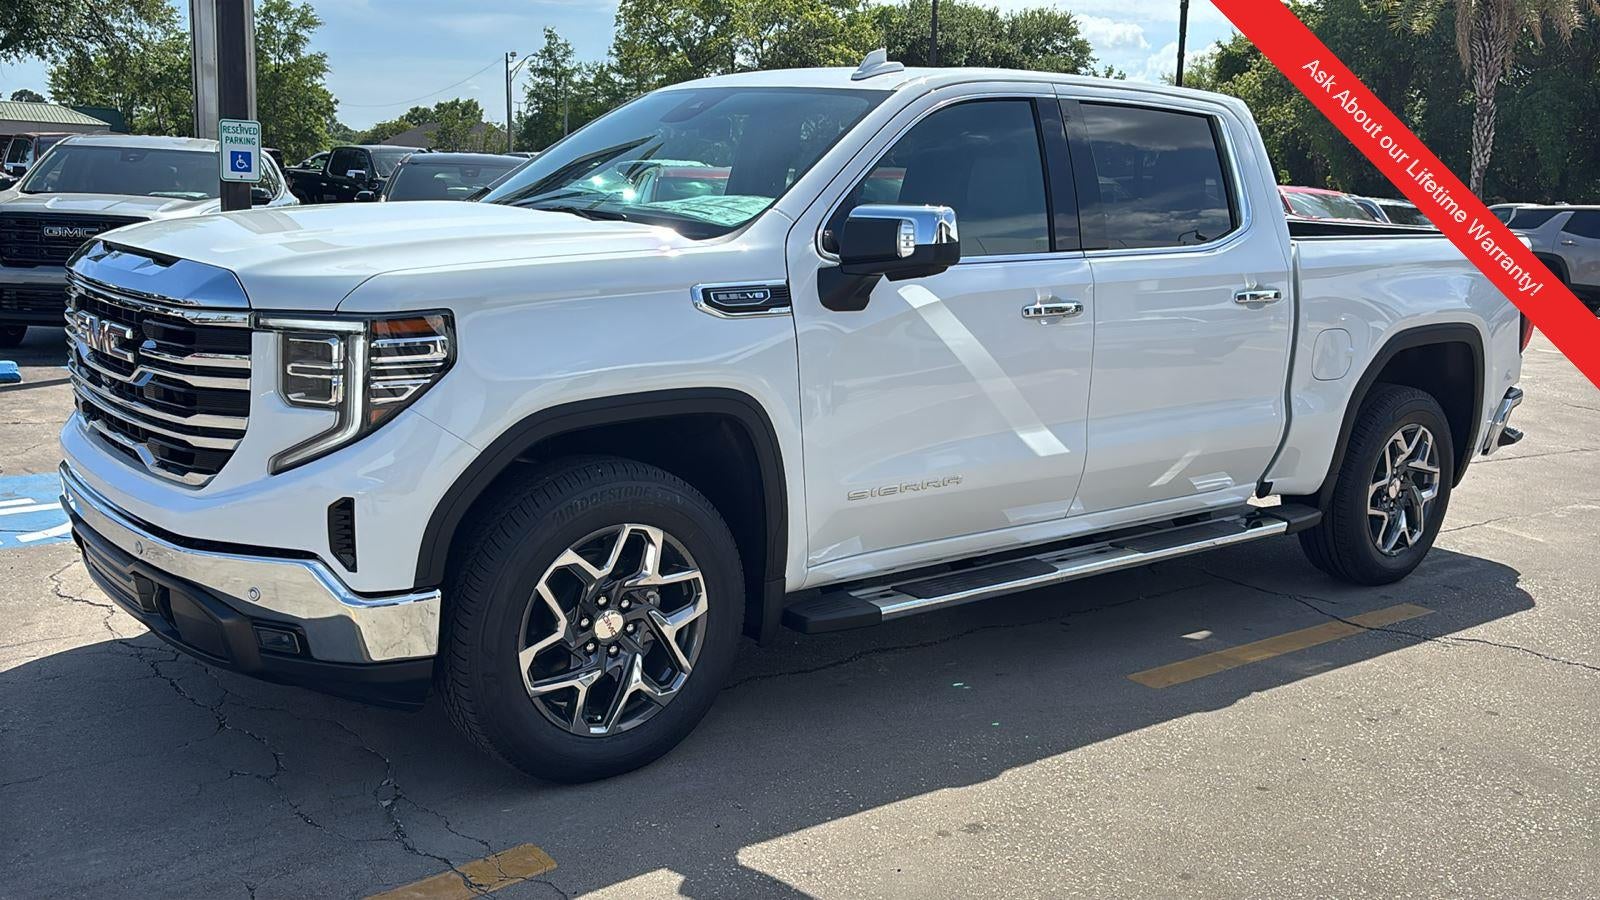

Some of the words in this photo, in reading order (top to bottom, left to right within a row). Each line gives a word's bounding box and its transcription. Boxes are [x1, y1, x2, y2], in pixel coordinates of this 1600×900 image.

[222, 125, 258, 136] RESERVED
[225, 136, 256, 146] PARKING
[43, 226, 99, 238] GMC
[75, 309, 135, 363] GMC
[847, 475, 964, 501] SIERRA
[552, 485, 652, 524] BRIDGESTONE
[602, 615, 618, 638] GMC
